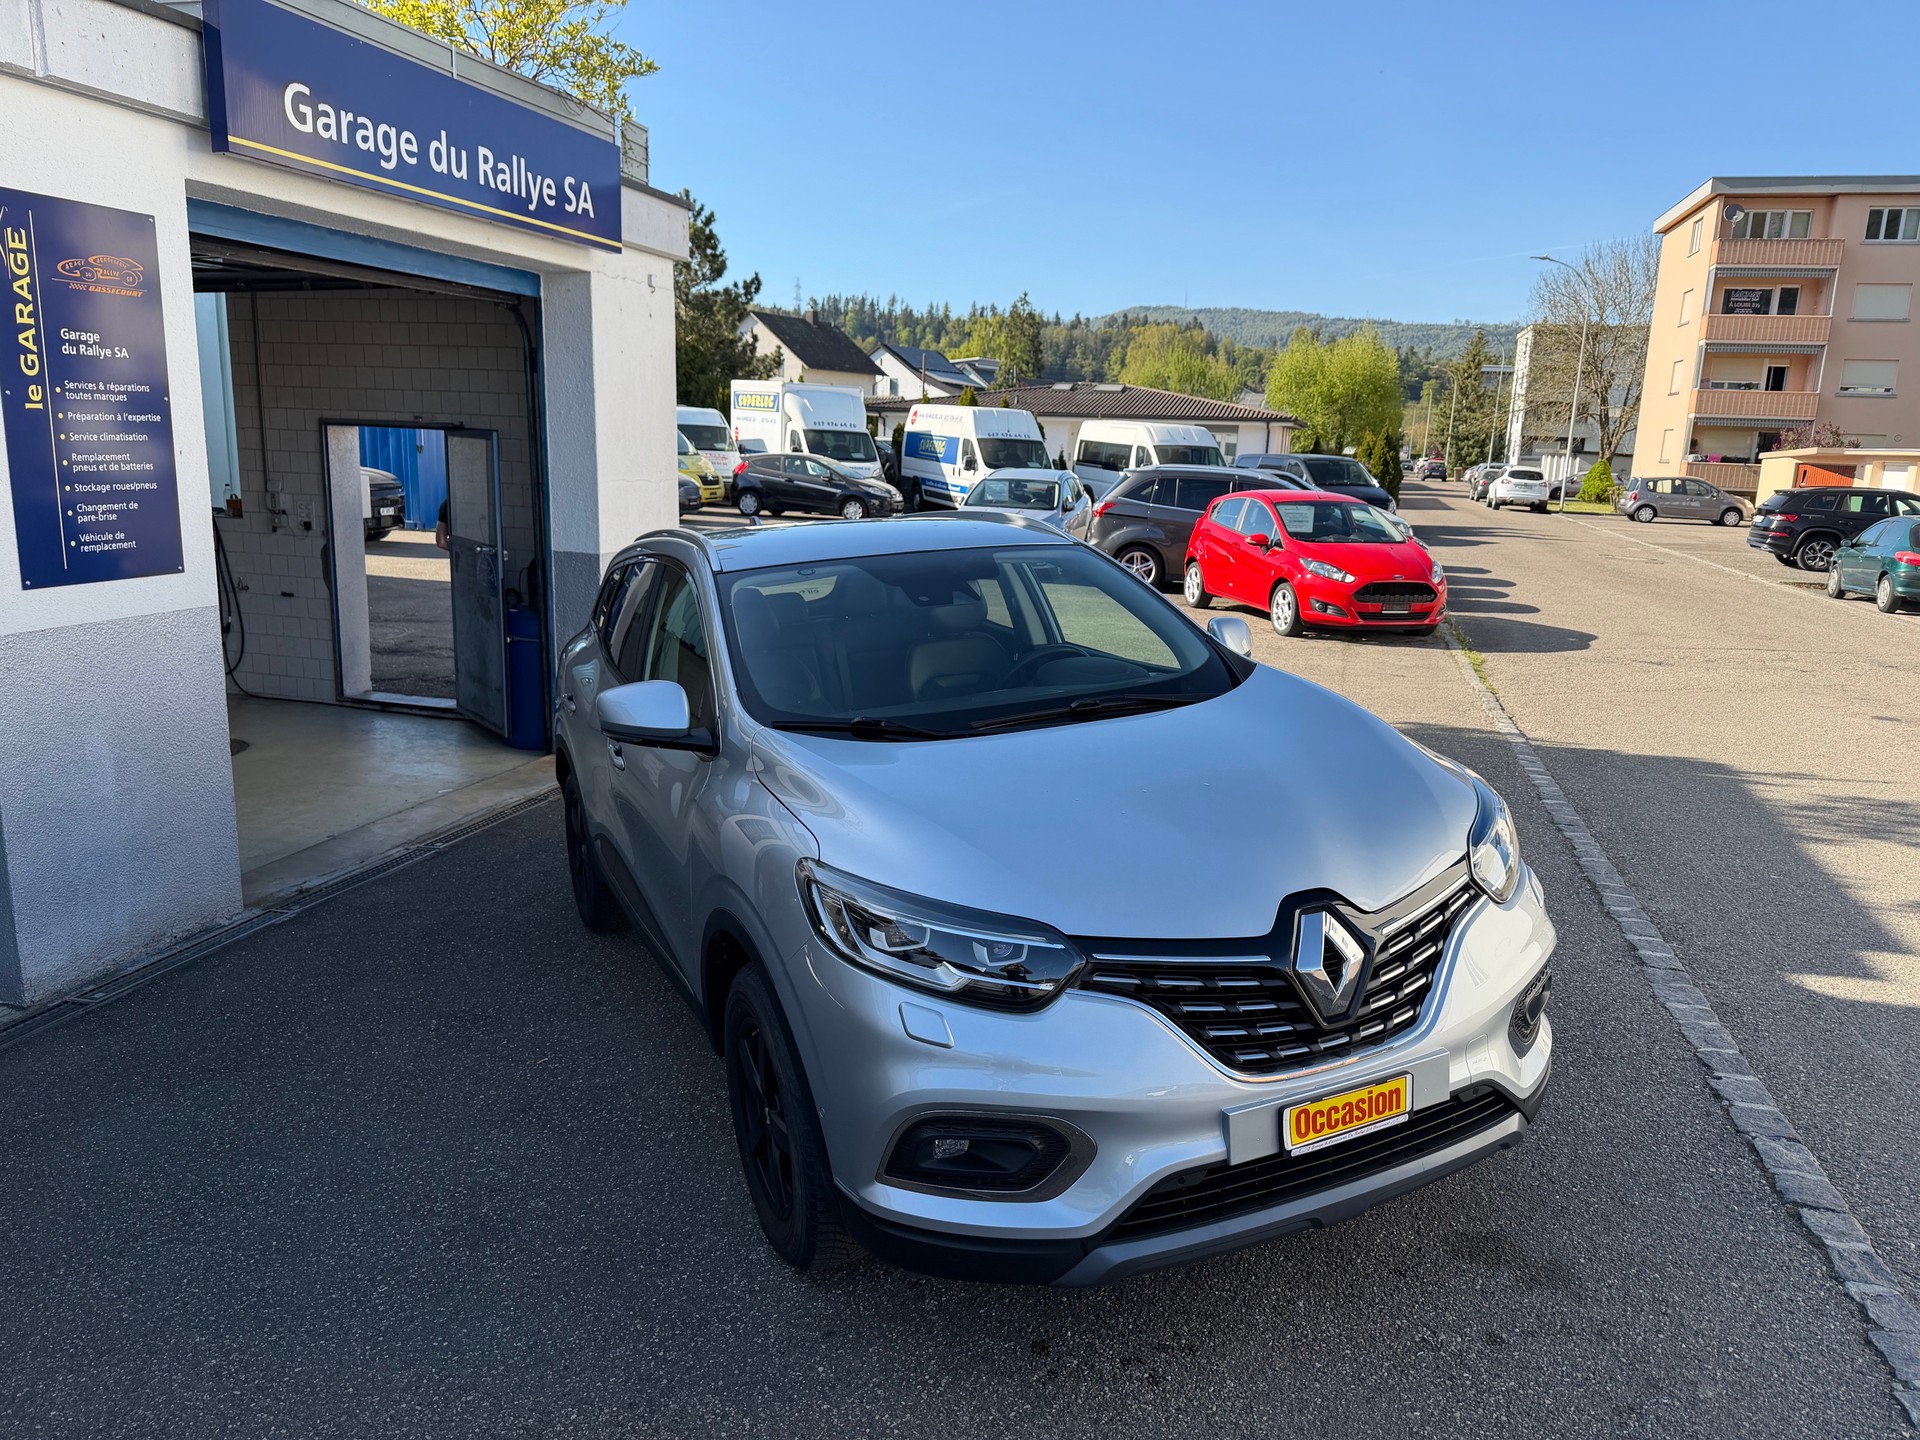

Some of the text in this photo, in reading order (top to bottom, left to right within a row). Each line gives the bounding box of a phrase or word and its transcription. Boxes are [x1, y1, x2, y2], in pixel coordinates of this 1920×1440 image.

[284, 82, 595, 219] Garage du Rallye SA
[88, 285, 144, 298] BASSECOURT
[7, 227, 43, 409] le GARAGE
[60, 328, 100, 344] Garage
[62, 343, 129, 360] du Rallye SA
[64, 380, 150, 392] Services & réparations
[65, 392, 127, 403] toutes marques
[68, 412, 161, 423] Préparation à l'expertise
[70, 432, 148, 441] Service climatisation
[72, 452, 130, 463] Remplacement
[72, 462, 154, 474] pneus et de batteries
[74, 482, 157, 493] Stockage roues/pneus
[76, 501, 139, 512] Changement de
[78, 512, 117, 524] pare-brise
[79, 531, 125, 542] Véhicule de
[81, 541, 136, 553] remplacement
[1295, 1087, 1401, 1139] Occasion
